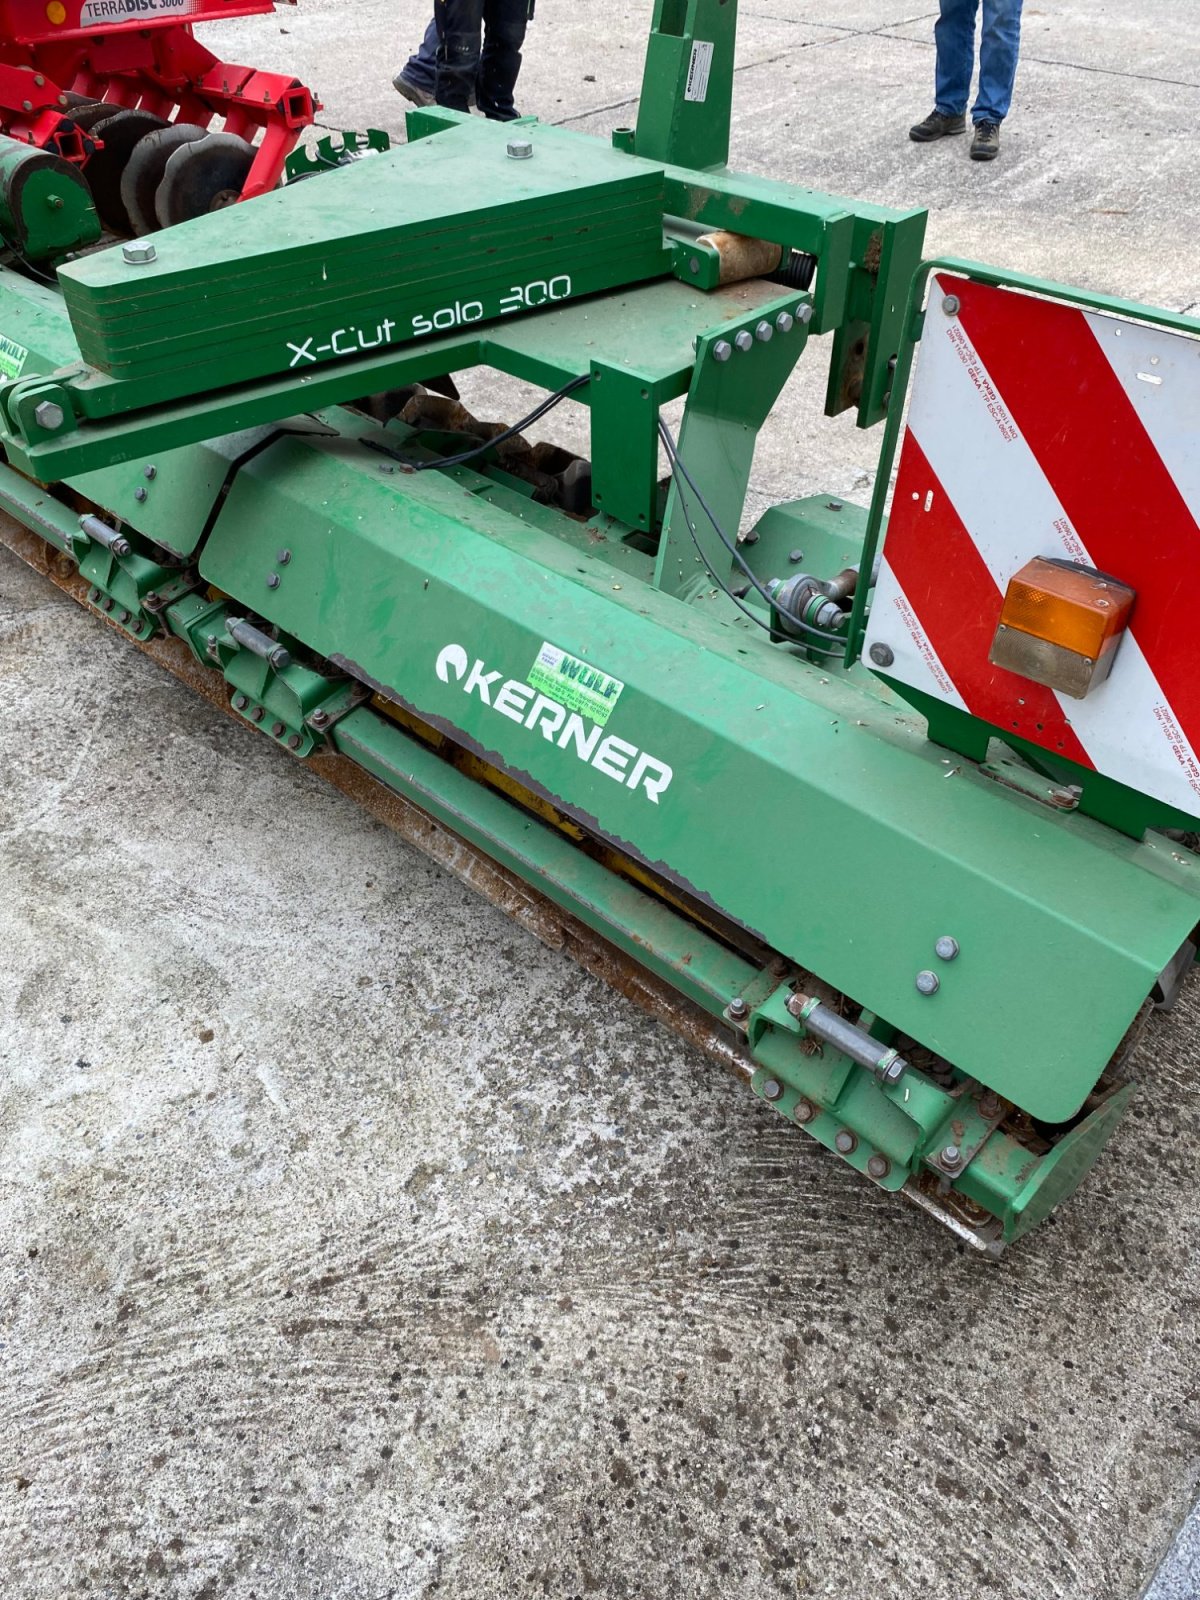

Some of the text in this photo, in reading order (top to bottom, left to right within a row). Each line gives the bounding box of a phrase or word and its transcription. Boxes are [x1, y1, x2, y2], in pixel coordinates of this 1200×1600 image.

[85, 0, 157, 17] TERRADISC
[286, 275, 571, 367] X-Cut solo 300
[946, 328, 956, 342] DIN
[956, 344, 968, 364] 11030
[968, 368, 982, 390] GEKA
[982, 393, 990, 402] TP
[982, 379, 996, 400] GEKA
[1008, 425, 1018, 439] DIN
[463, 659, 673, 805] KERNER
[1153, 708, 1163, 720] DIN
[1172, 745, 1185, 765] GEKA
[1187, 756, 1200, 777] GEKA
